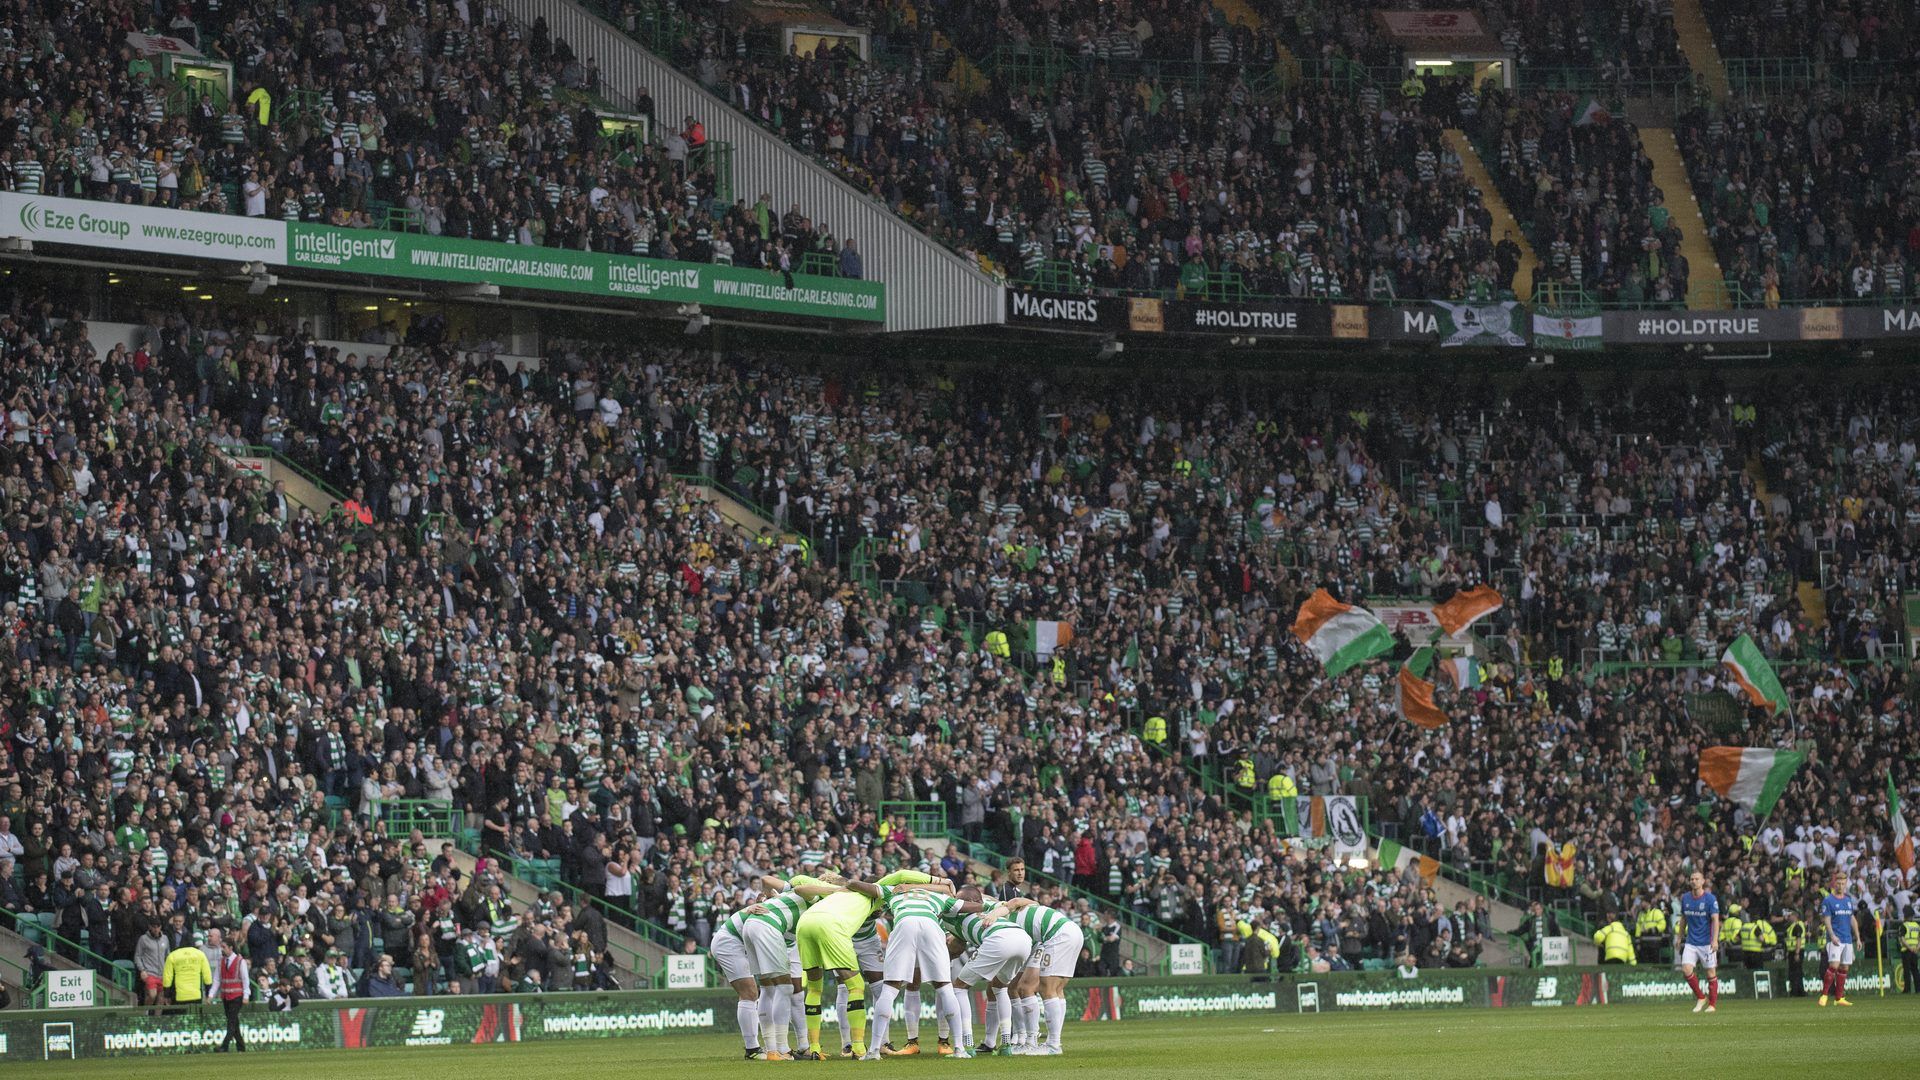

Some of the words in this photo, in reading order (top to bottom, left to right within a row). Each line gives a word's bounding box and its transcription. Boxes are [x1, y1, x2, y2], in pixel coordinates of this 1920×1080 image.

[44, 210, 75, 230] Eze
[79, 213, 130, 240] Group
[142, 223, 276, 250] www.ezegroup.com
[295, 228, 380, 261] intelligent
[295, 251, 310, 262] CAR
[311, 254, 341, 266] LEASING
[411, 249, 593, 281] WWW.INTELLIGENTCARLEASING.COM
[609, 260, 686, 291] intelligent
[609, 282, 623, 292] CAR
[624, 283, 651, 295] LEASING
[713, 279, 877, 310] WWW.INTELLIGENTCARLEASING.COM
[1012, 292, 1098, 322] MAGNERS
[1195, 309, 1298, 329] #HOLDTRUE
[1638, 318, 1760, 336] #HOLDTRUE
[1179, 949, 1194, 958] Exit
[1549, 941, 1562, 950] Exit
[677, 960, 695, 970] Exit
[1173, 961, 1191, 971] Gate
[1192, 960, 1202, 970] 12
[60, 976, 82, 987] Exit
[669, 973, 691, 984] Gate
[694, 973, 704, 983] 11
[50, 991, 77, 1003] Gate
[79, 990, 92, 1002] 10
[1138, 991, 1276, 1012] newbalance.com/football
[1336, 986, 1464, 1006] newbalance.com/football
[544, 1008, 714, 1033] newbalance.com/football
